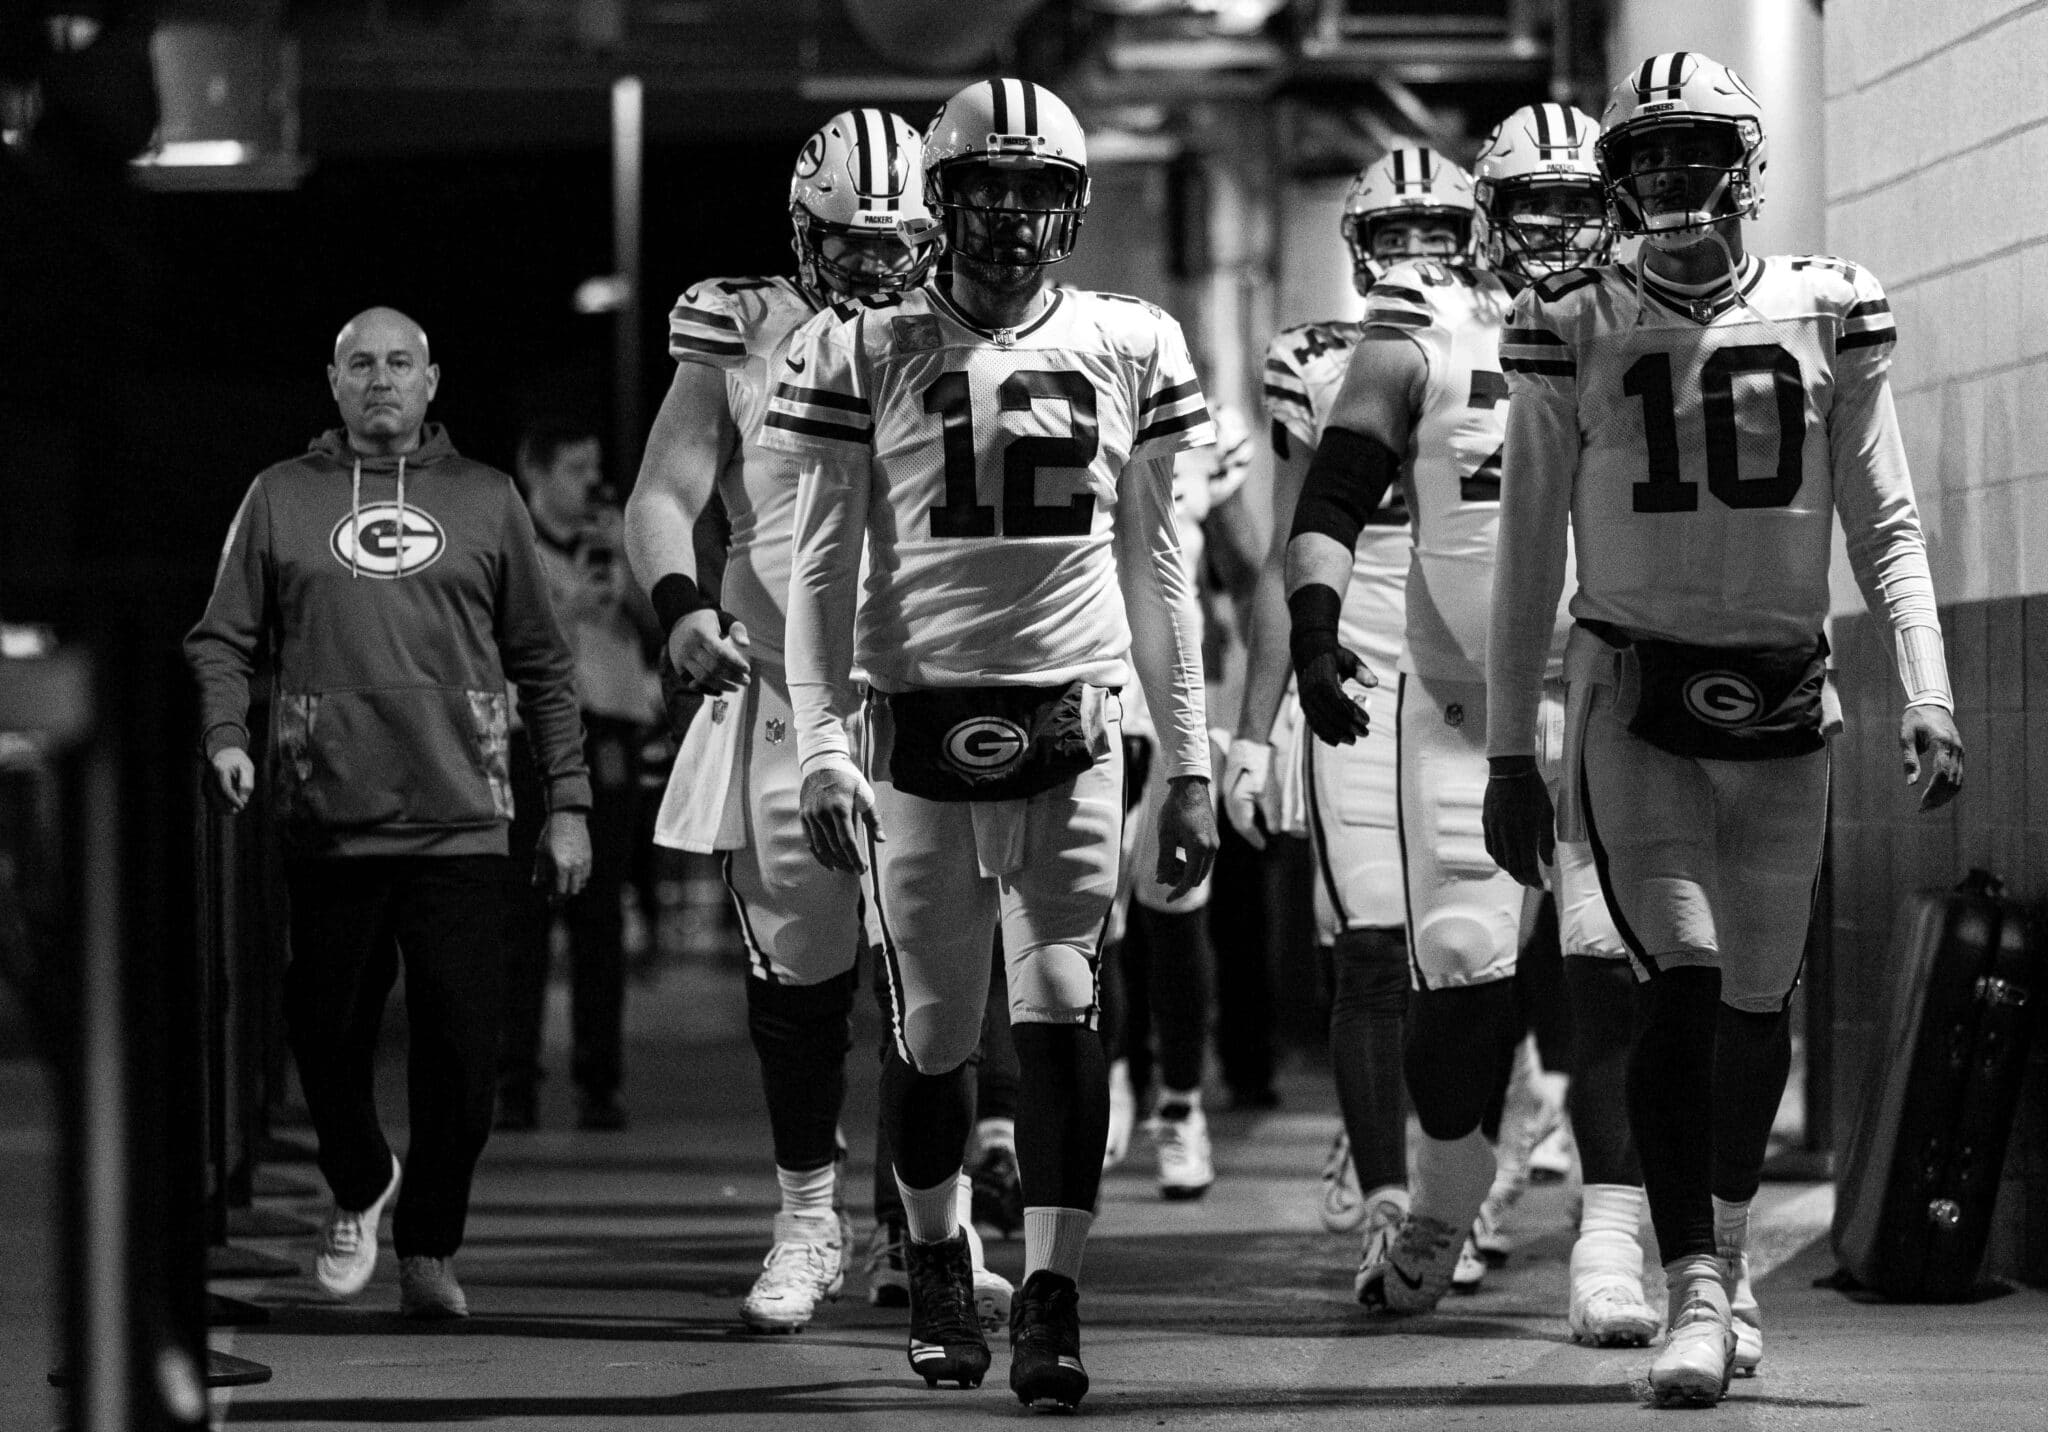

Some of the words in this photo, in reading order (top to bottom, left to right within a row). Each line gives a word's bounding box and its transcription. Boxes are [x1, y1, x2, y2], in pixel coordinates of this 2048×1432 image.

[1643, 102, 1675, 114] PACKERS
[1003, 136, 1031, 146] PACKERS
[864, 215, 893, 225] PACKERS
[1622, 343, 1806, 513] 10
[922, 369, 1099, 538] 12
[336, 506, 439, 574] G
[1688, 675, 1757, 722] G
[948, 721, 1021, 768] G
